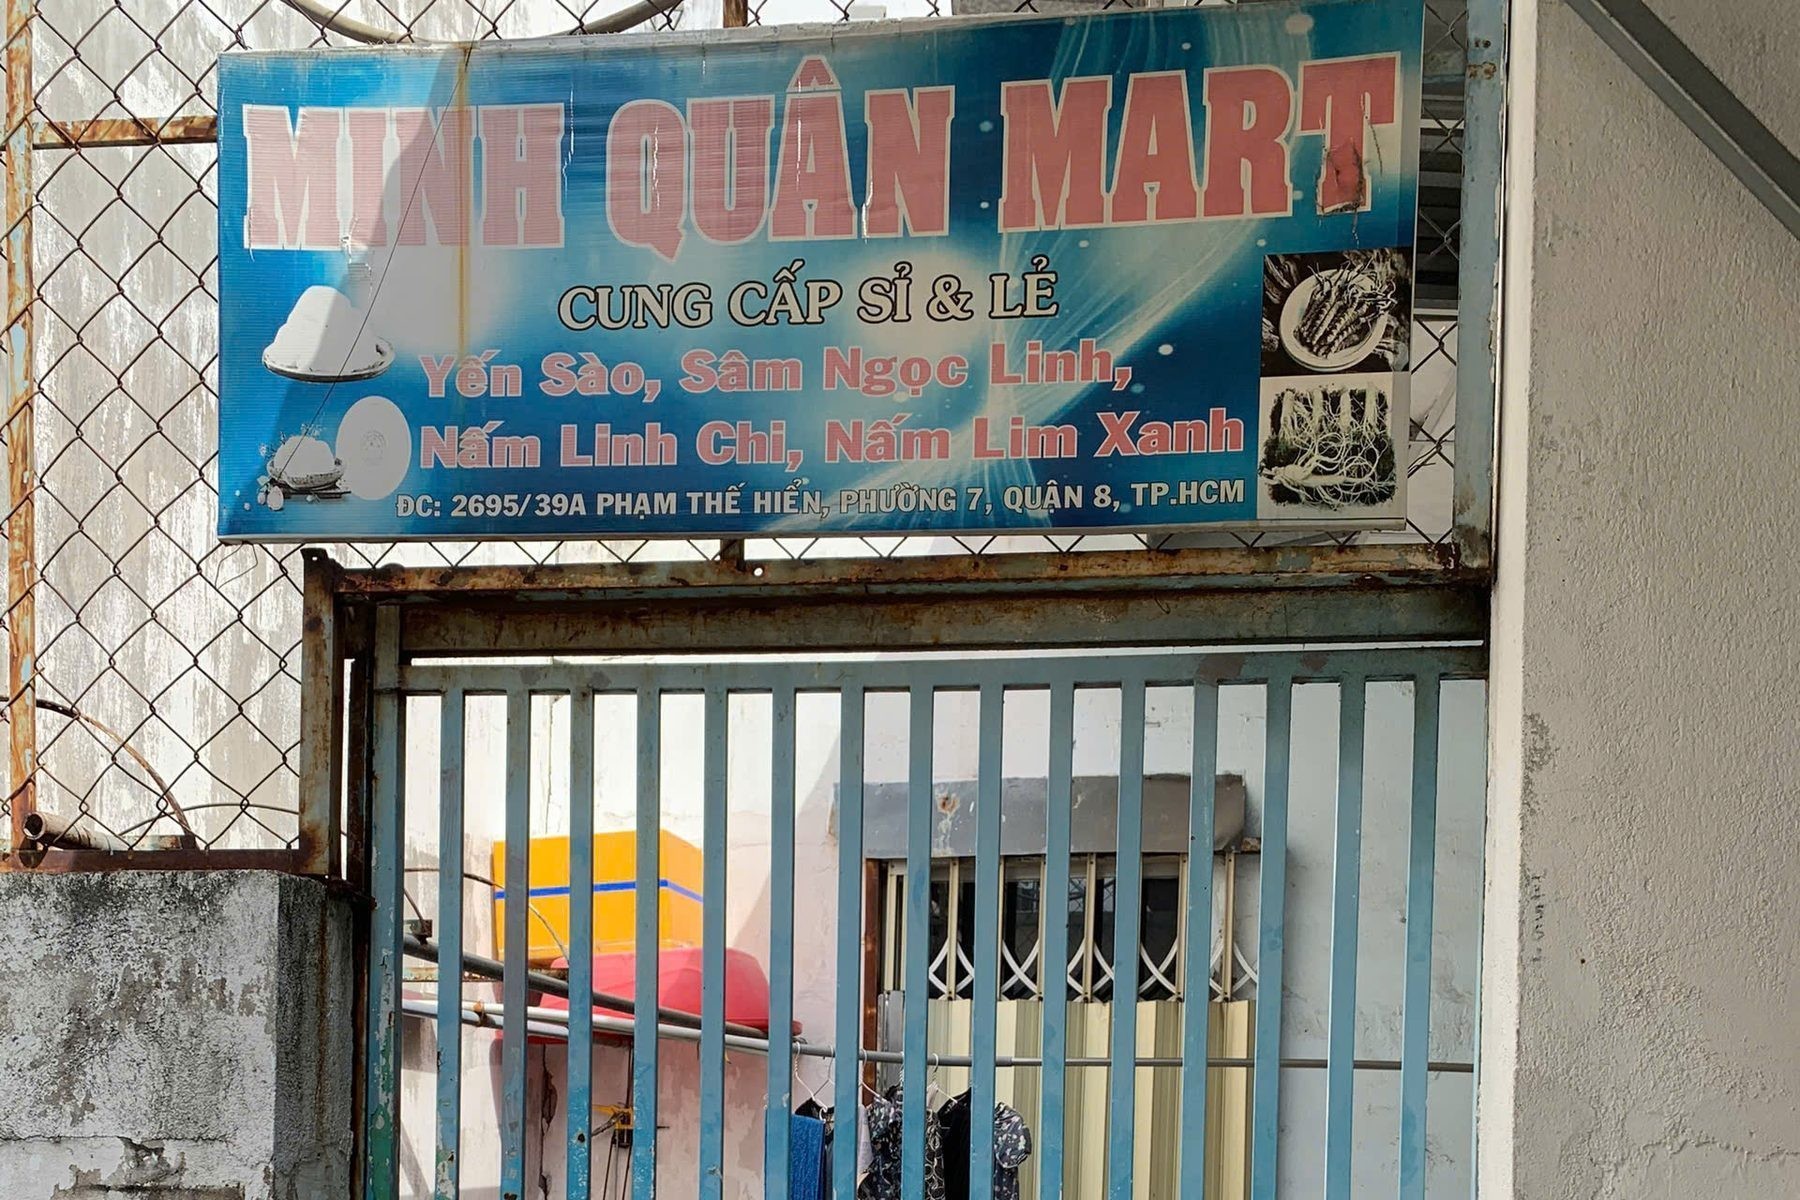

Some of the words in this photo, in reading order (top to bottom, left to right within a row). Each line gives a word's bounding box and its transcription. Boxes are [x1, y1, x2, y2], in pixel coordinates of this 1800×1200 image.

[242, 101, 565, 249] MINH
[605, 53, 955, 261] QUÂN
[998, 50, 1401, 233] MART
[557, 283, 712, 330] CUNG
[727, 258, 842, 327] CẤP
[857, 261, 912, 324] SỈ
[927, 281, 974, 322] &
[989, 255, 1060, 318] LẺ
[418, 349, 522, 398] Yến
[539, 351, 661, 403] Sào,
[678, 349, 804, 394] Sâm
[823, 346, 969, 397] Ngọc
[989, 338, 1133, 391] Linh,
[419, 420, 541, 469] Nấm
[559, 424, 679, 468] Linh
[695, 420, 804, 471] Chi,
[825, 406, 951, 465] Nấm
[972, 413, 1079, 460] Lim
[1094, 407, 1246, 459] Xanh
[395, 494, 441, 519] ĐC:
[450, 492, 586, 519] 2695/39A
[596, 493, 678, 522] PHẠM
[686, 480, 746, 515] THẾ
[753, 478, 830, 518] HIỂN,
[839, 481, 959, 515] PHƯỜNG
[967, 487, 993, 516] 7,
[1002, 480, 1083, 515] QUẬN
[1093, 486, 1121, 512] 8,
[1131, 479, 1246, 507] TP.HCM
